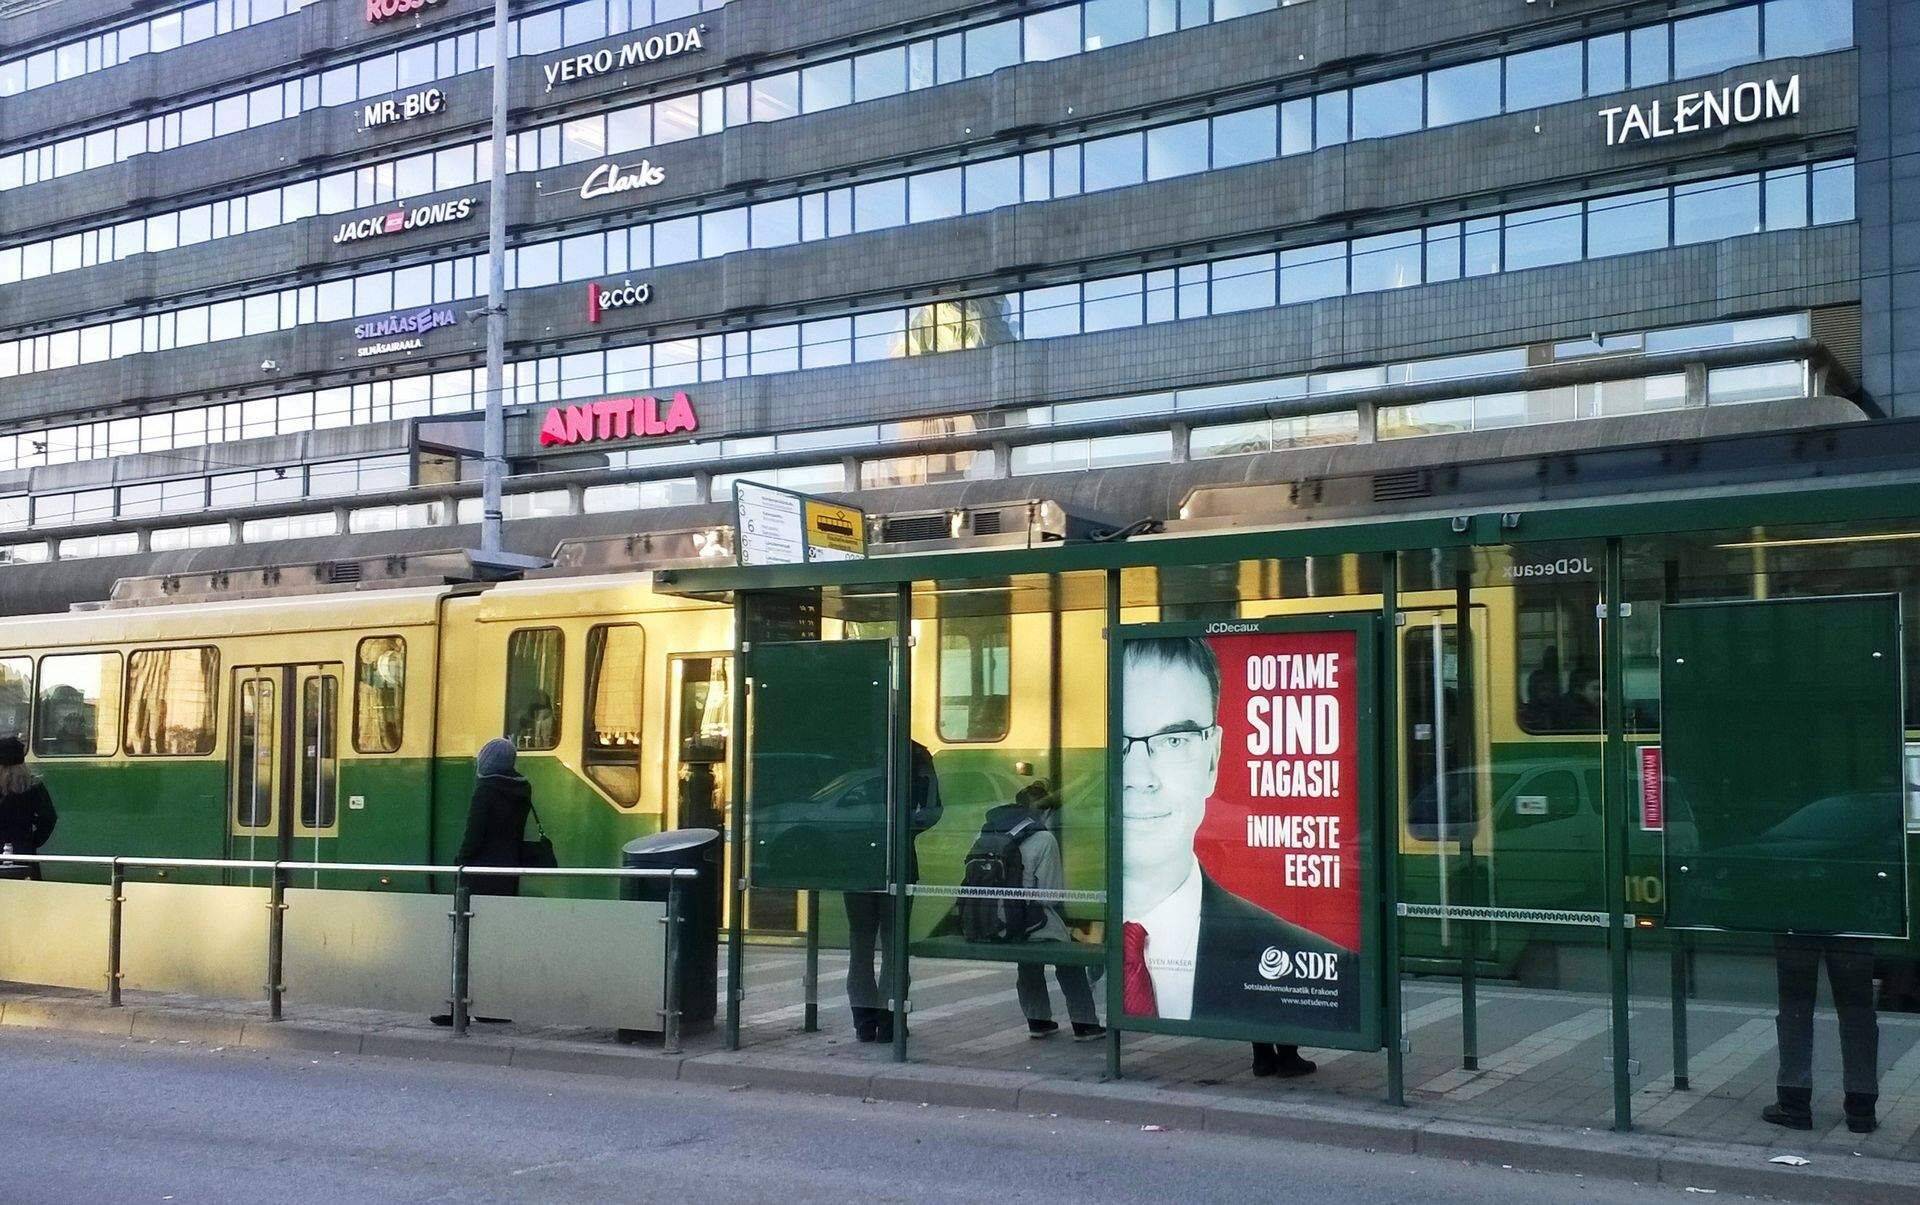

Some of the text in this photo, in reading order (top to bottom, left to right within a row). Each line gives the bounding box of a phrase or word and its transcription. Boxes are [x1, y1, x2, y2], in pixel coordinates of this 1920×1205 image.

[544, 27, 701, 84] VERO MODA
[364, 88, 440, 127] MR. BIG
[1598, 75, 1800, 146] TALENOM
[580, 159, 665, 199] Clarks
[332, 216, 386, 243] JACK
[404, 197, 471, 229] JONES
[598, 285, 649, 309] ecco
[539, 390, 698, 447] ANTTILA
[747, 519, 755, 532] 6
[1205, 622, 1260, 634] JCDecaux
[1247, 653, 1339, 690] OOTAME
[1246, 694, 1340, 756] SIND
[1247, 760, 1340, 798] TAGASI!
[1295, 951, 1338, 981] SDE
[1281, 998, 1338, 1008] www.sotsdem.ee
[1311, 987, 1338, 997] Erakond
